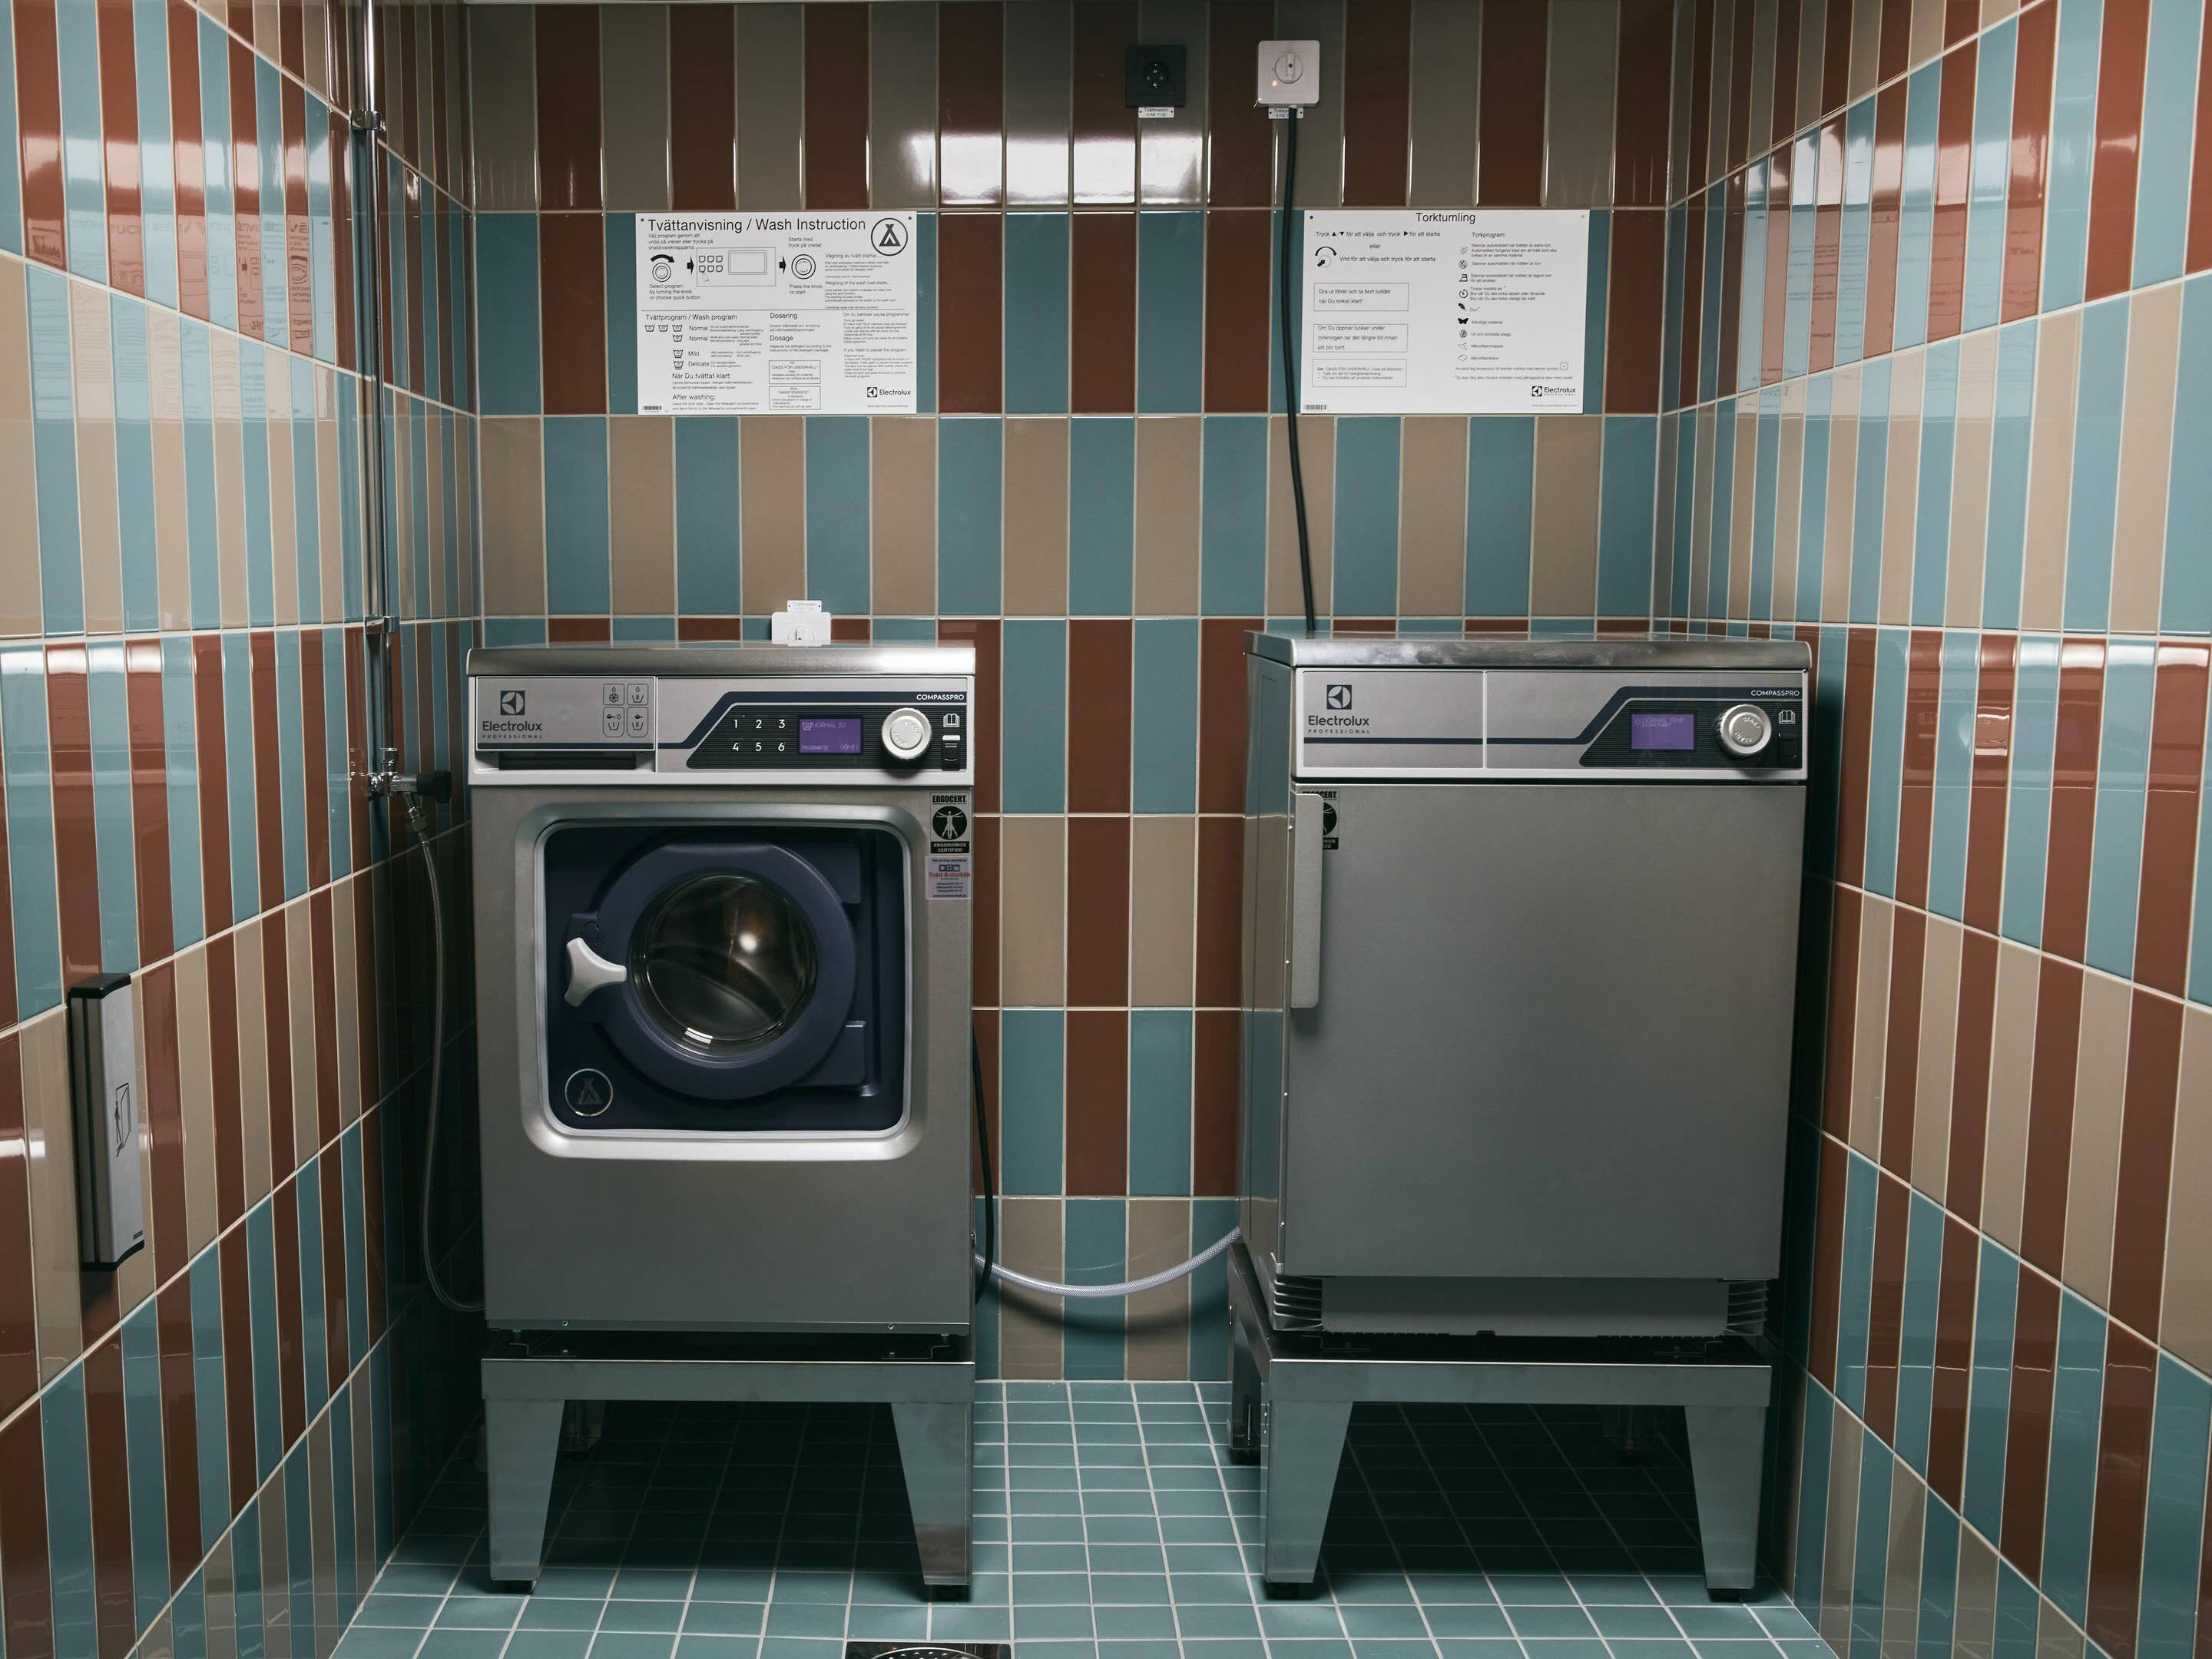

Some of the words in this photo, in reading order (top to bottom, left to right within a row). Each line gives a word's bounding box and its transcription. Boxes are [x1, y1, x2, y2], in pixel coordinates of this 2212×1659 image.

[1416, 213, 1475, 224] Torktumling
[648, 219, 743, 233] Tvättanvisning
[747, 218, 752, 231] /
[756, 218, 792, 230] Wash
[797, 218, 866, 230] Instruction
[733, 720, 737, 728] 1
[756, 720, 762, 728] 2
[779, 720, 785, 728] 3
[1309, 715, 1369, 726] Electrolux
[482, 721, 541, 731] Electrolux
[733, 743, 740, 751] 4
[755, 743, 762, 751] 5
[779, 743, 785, 751] 6
